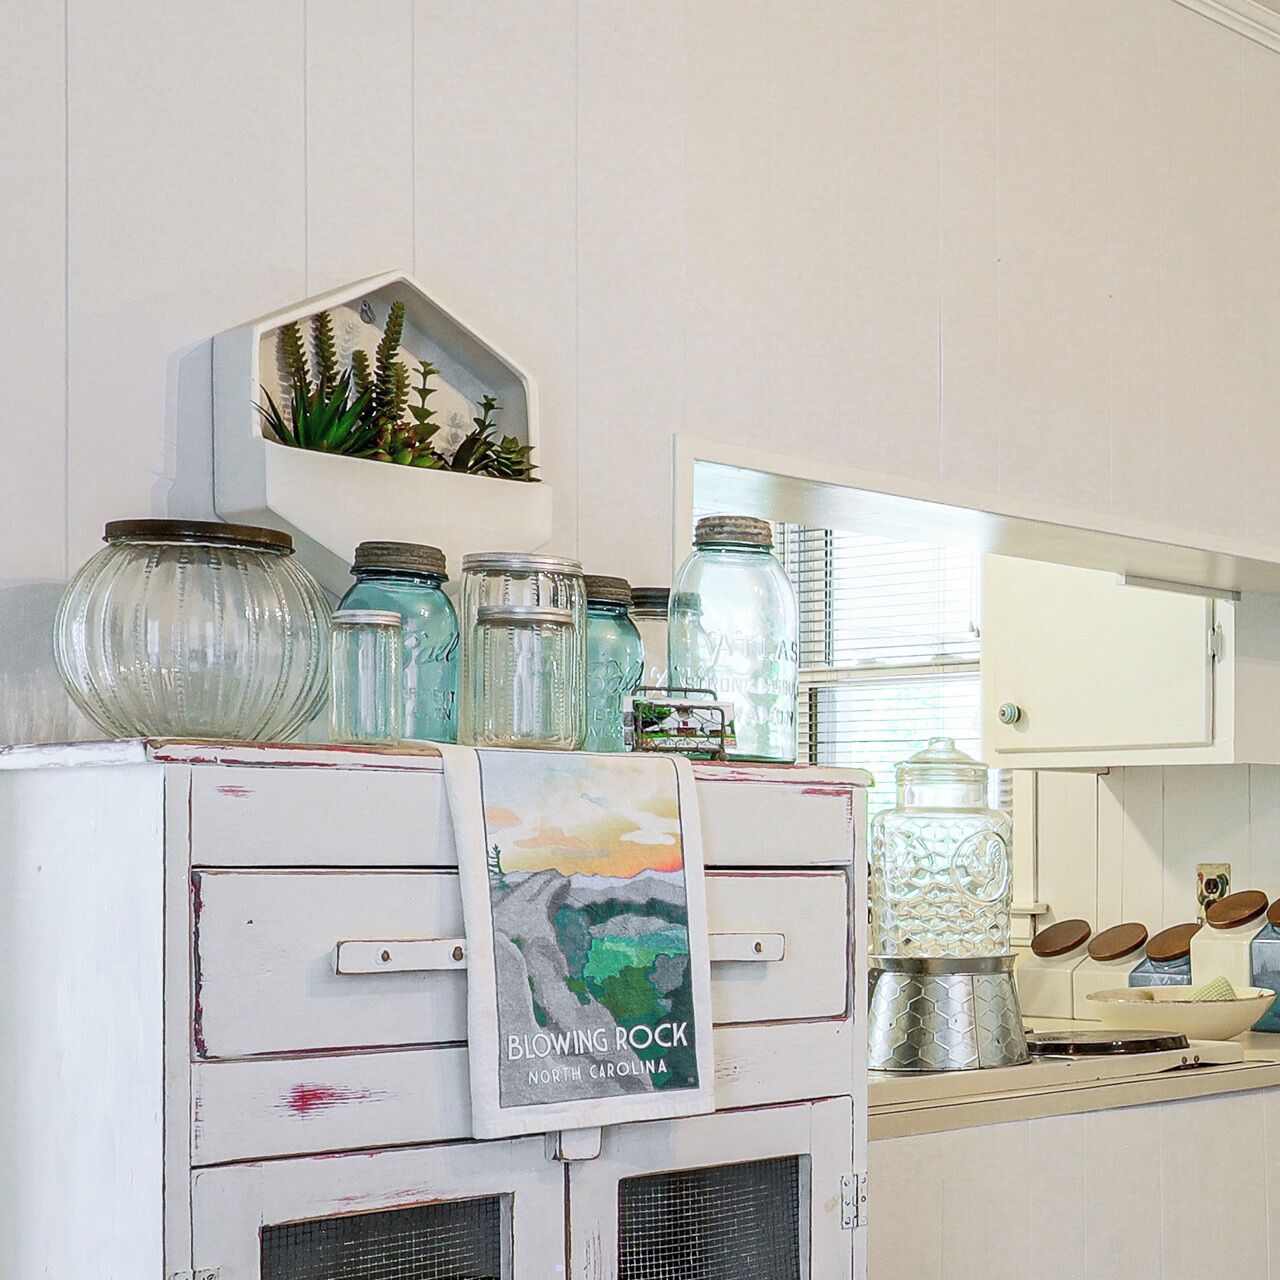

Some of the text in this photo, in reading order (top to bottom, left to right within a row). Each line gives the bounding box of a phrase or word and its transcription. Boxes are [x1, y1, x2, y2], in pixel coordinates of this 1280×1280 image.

[507, 1021, 688, 1061] BLOWING ROCK
[528, 1066, 582, 1085] NORTH
[589, 1058, 668, 1080] CAROLINA
